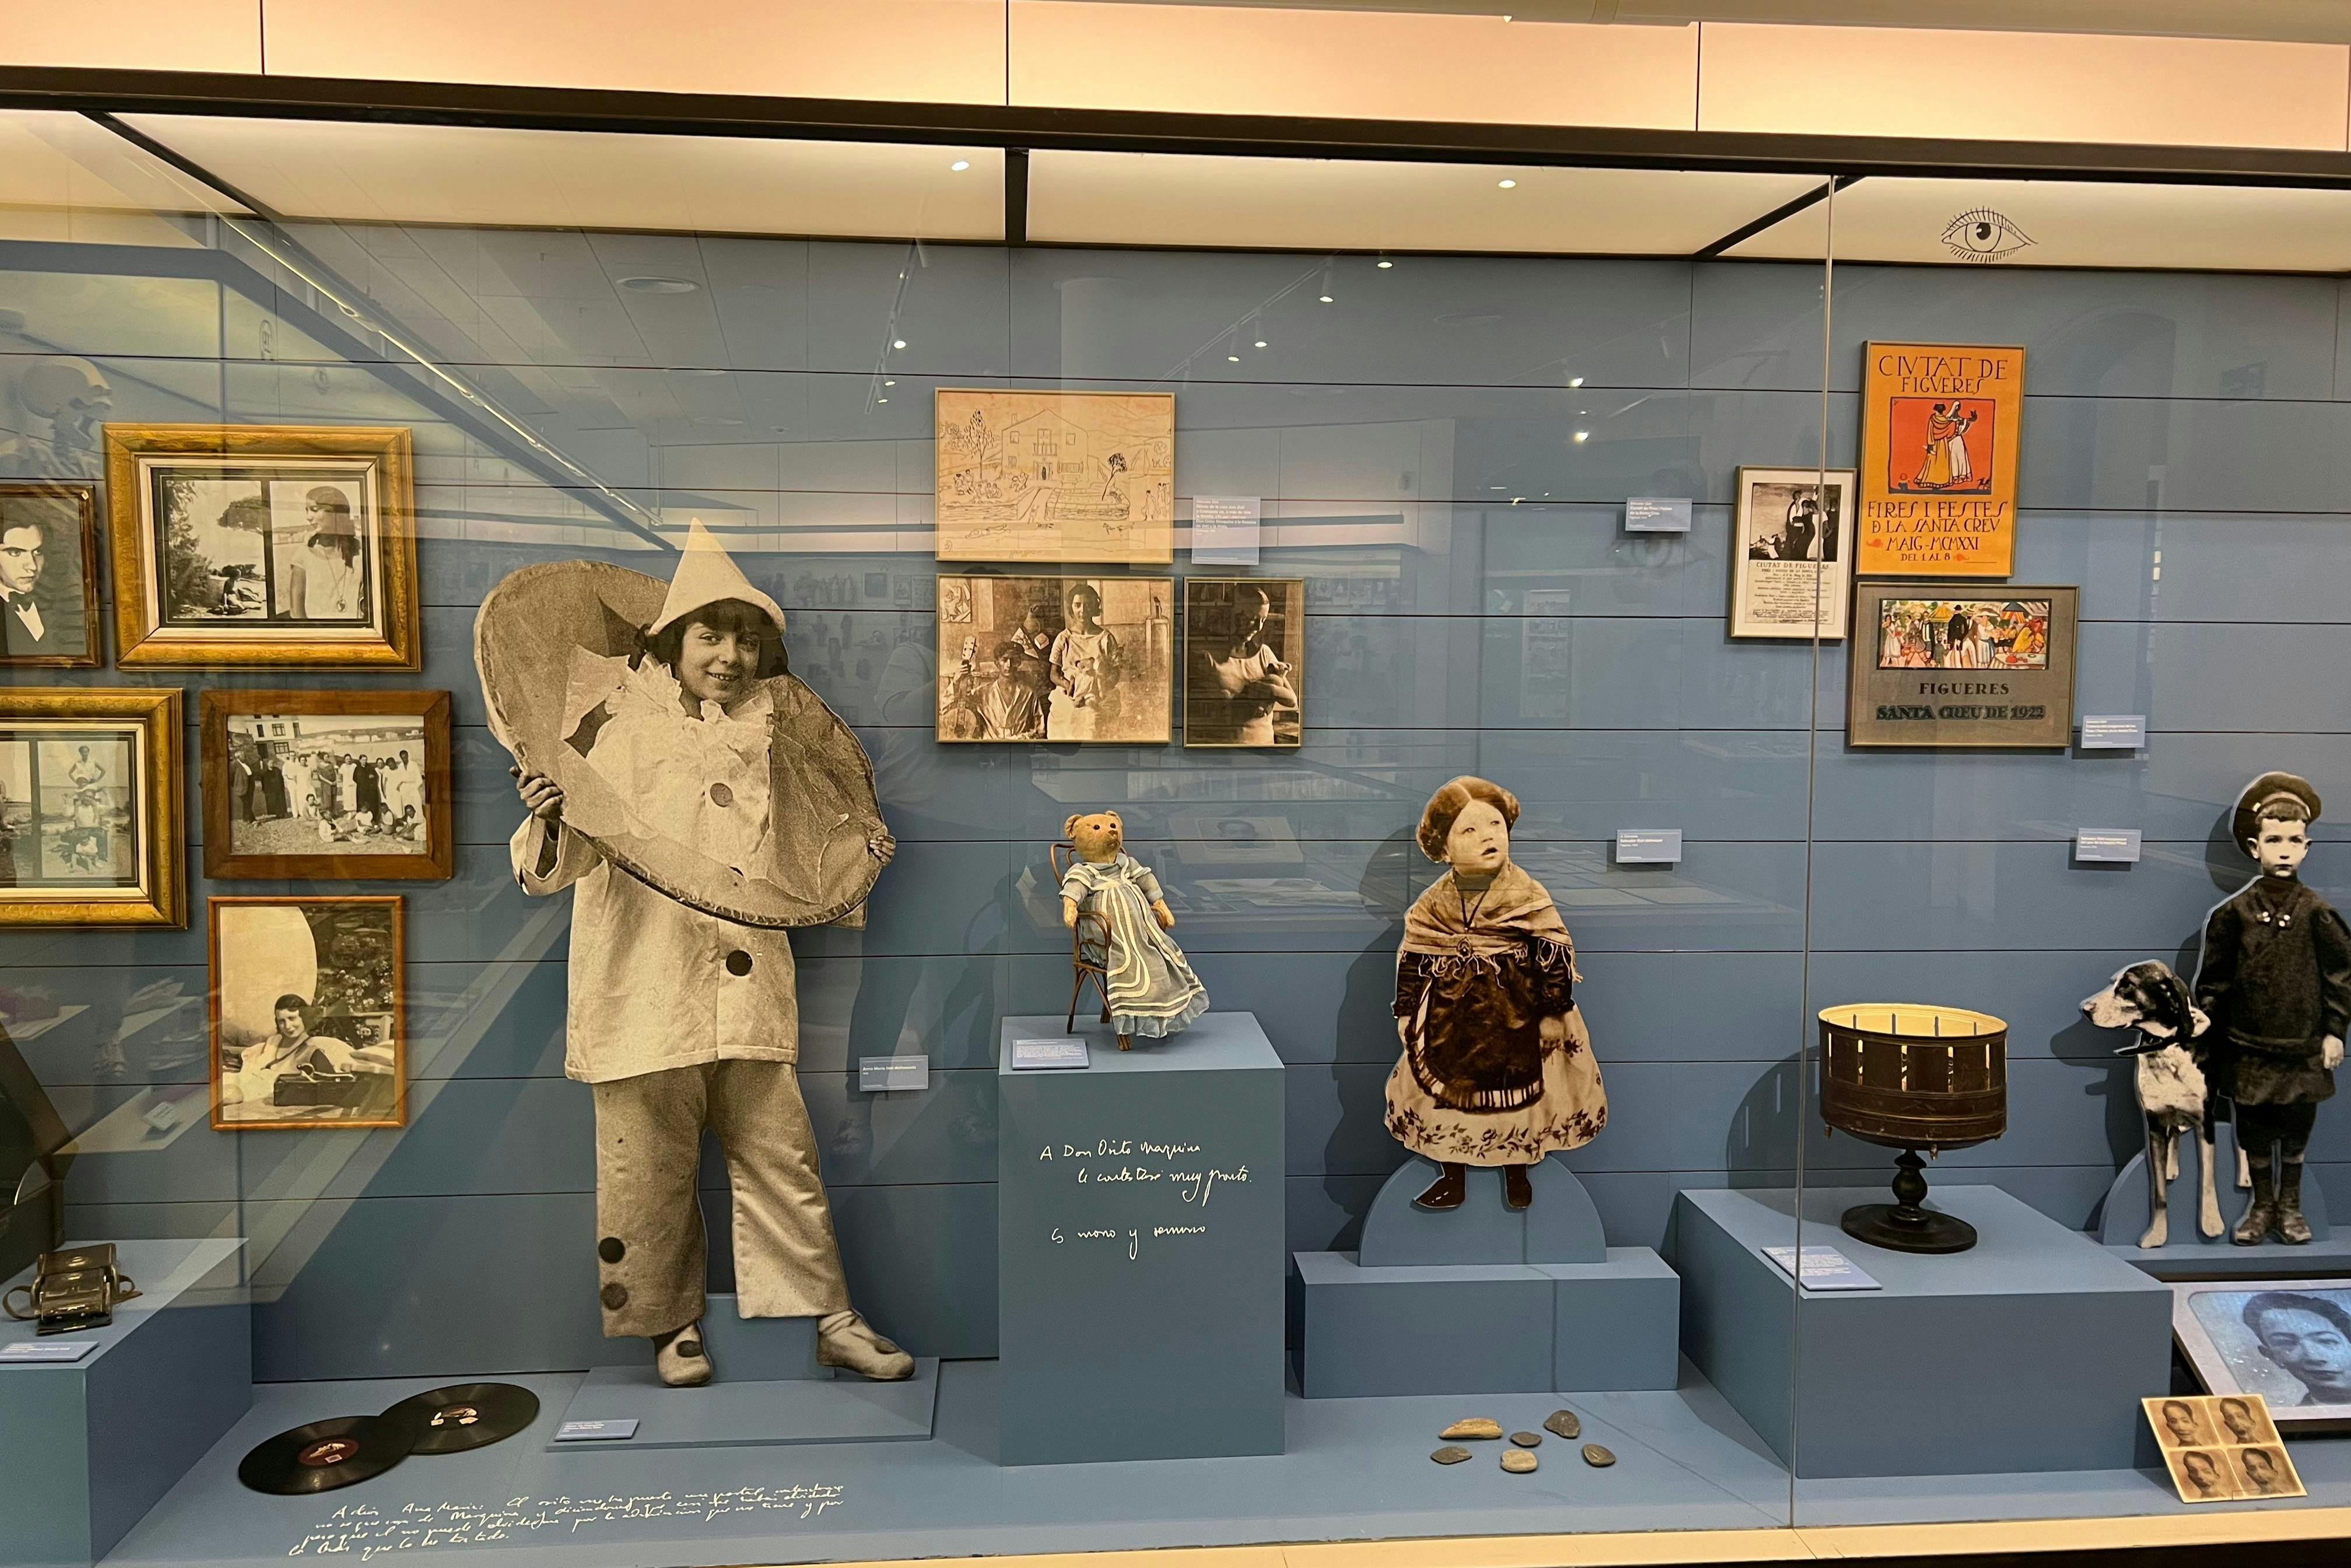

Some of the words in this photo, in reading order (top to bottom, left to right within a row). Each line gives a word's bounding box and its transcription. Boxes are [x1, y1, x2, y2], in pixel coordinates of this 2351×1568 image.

[1977, 359, 2008, 380] DE
[1867, 500, 1918, 518] FIRES
[1924, 501, 1932, 518] I
[1937, 500, 2009, 518] FESTES
[1885, 520, 1907, 533] LA
[1912, 518, 1961, 532] SANTA
[1900, 553, 1918, 562] DEL
[1944, 553, 1951, 561] 8
[1919, 682, 2009, 695] FIGUERES
[1876, 705, 1936, 720] SANTA
[1983, 705, 2008, 720] DE
[2009, 705, 2046, 720] 1922
[1040, 1145, 1052, 1161] A
[1063, 1145, 1092, 1157] Don
[1169, 1171, 1202, 1202] muy
[1129, 1229, 1138, 1260] y
